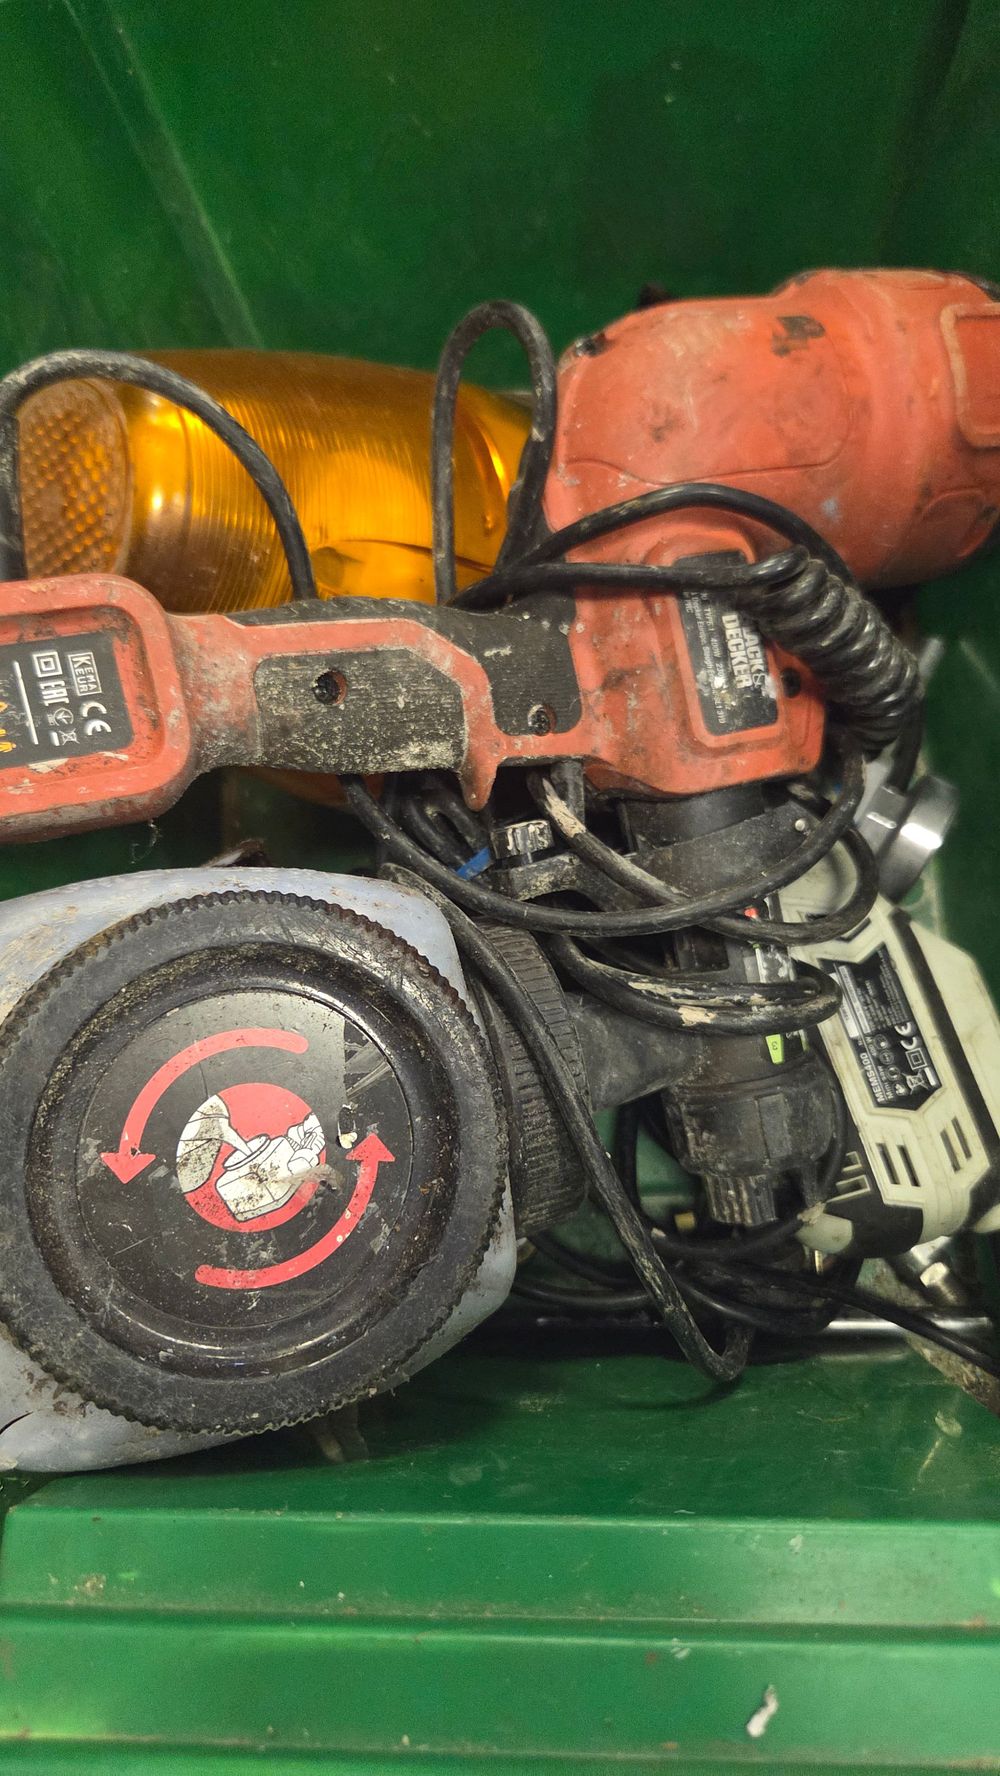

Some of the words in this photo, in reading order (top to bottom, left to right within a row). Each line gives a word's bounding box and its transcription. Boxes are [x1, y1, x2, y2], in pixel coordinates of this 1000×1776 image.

[722, 614, 753, 689] DECKER
[82, 701, 112, 735] CE
[895, 1021, 917, 1050] CE
[860, 1052, 885, 1103] MEMS400
